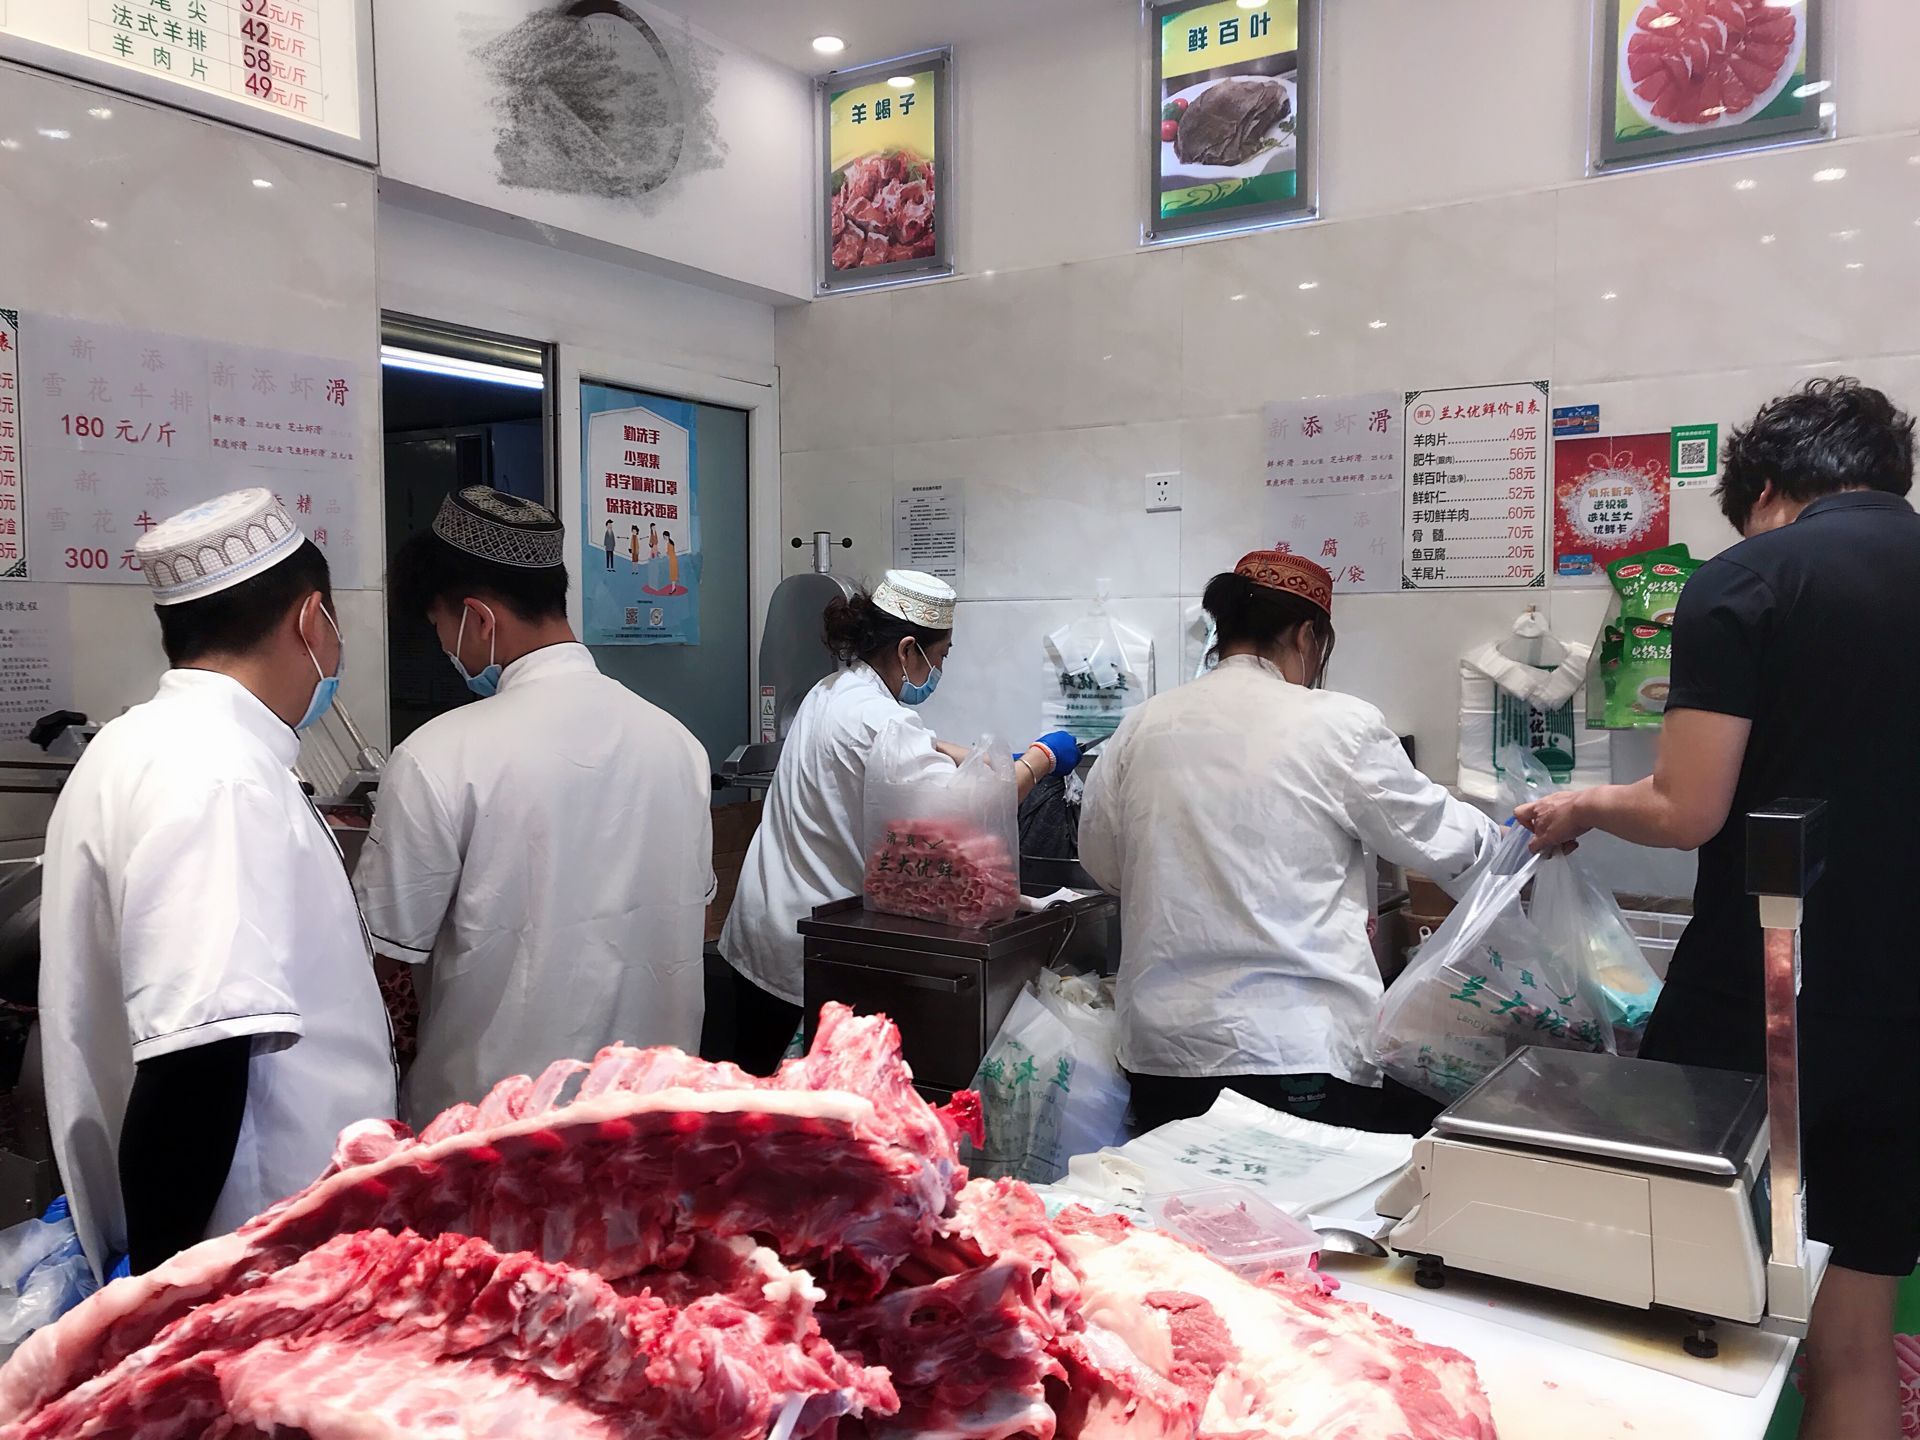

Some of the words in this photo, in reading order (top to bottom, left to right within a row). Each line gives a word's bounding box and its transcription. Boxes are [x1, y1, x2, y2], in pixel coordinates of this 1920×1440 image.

[112, 4, 207, 51] 法式羊排
[1188, 11, 1271, 52] 鲜百叶
[112, 33, 208, 82] 羊肉片
[851, 92, 916, 125] 羊蝎子
[42, 372, 194, 414] 雪花牛排
[1439, 399, 1540, 421] 兰大优鲜价目表
[60, 413, 105, 438] 180
[115, 419, 177, 448] 元/斤
[623, 425, 660, 445] 勤洗手
[1413, 432, 1448, 447] 羊肉片
[1509, 427, 1536, 441] 49元
[624, 450, 660, 470] 少聚集
[1509, 446, 1536, 460] 56元
[1508, 466, 1536, 480] 58元
[605, 472, 678, 496] 科学佩戴口罩
[1412, 490, 1447, 504] 鲜虾仁
[1508, 486, 1535, 500] 52元
[606, 497, 678, 520] 保持社交距离
[1412, 508, 1470, 523] 手切鲜羊肉
[1508, 505, 1535, 520] 60元
[1507, 525, 1534, 540] 70元
[65, 548, 109, 569] 300
[1411, 547, 1446, 561] 鱼豆腐
[1507, 545, 1535, 559] 20元
[1411, 567, 1446, 580] 羊尾片
[1507, 565, 1535, 578] 20元
